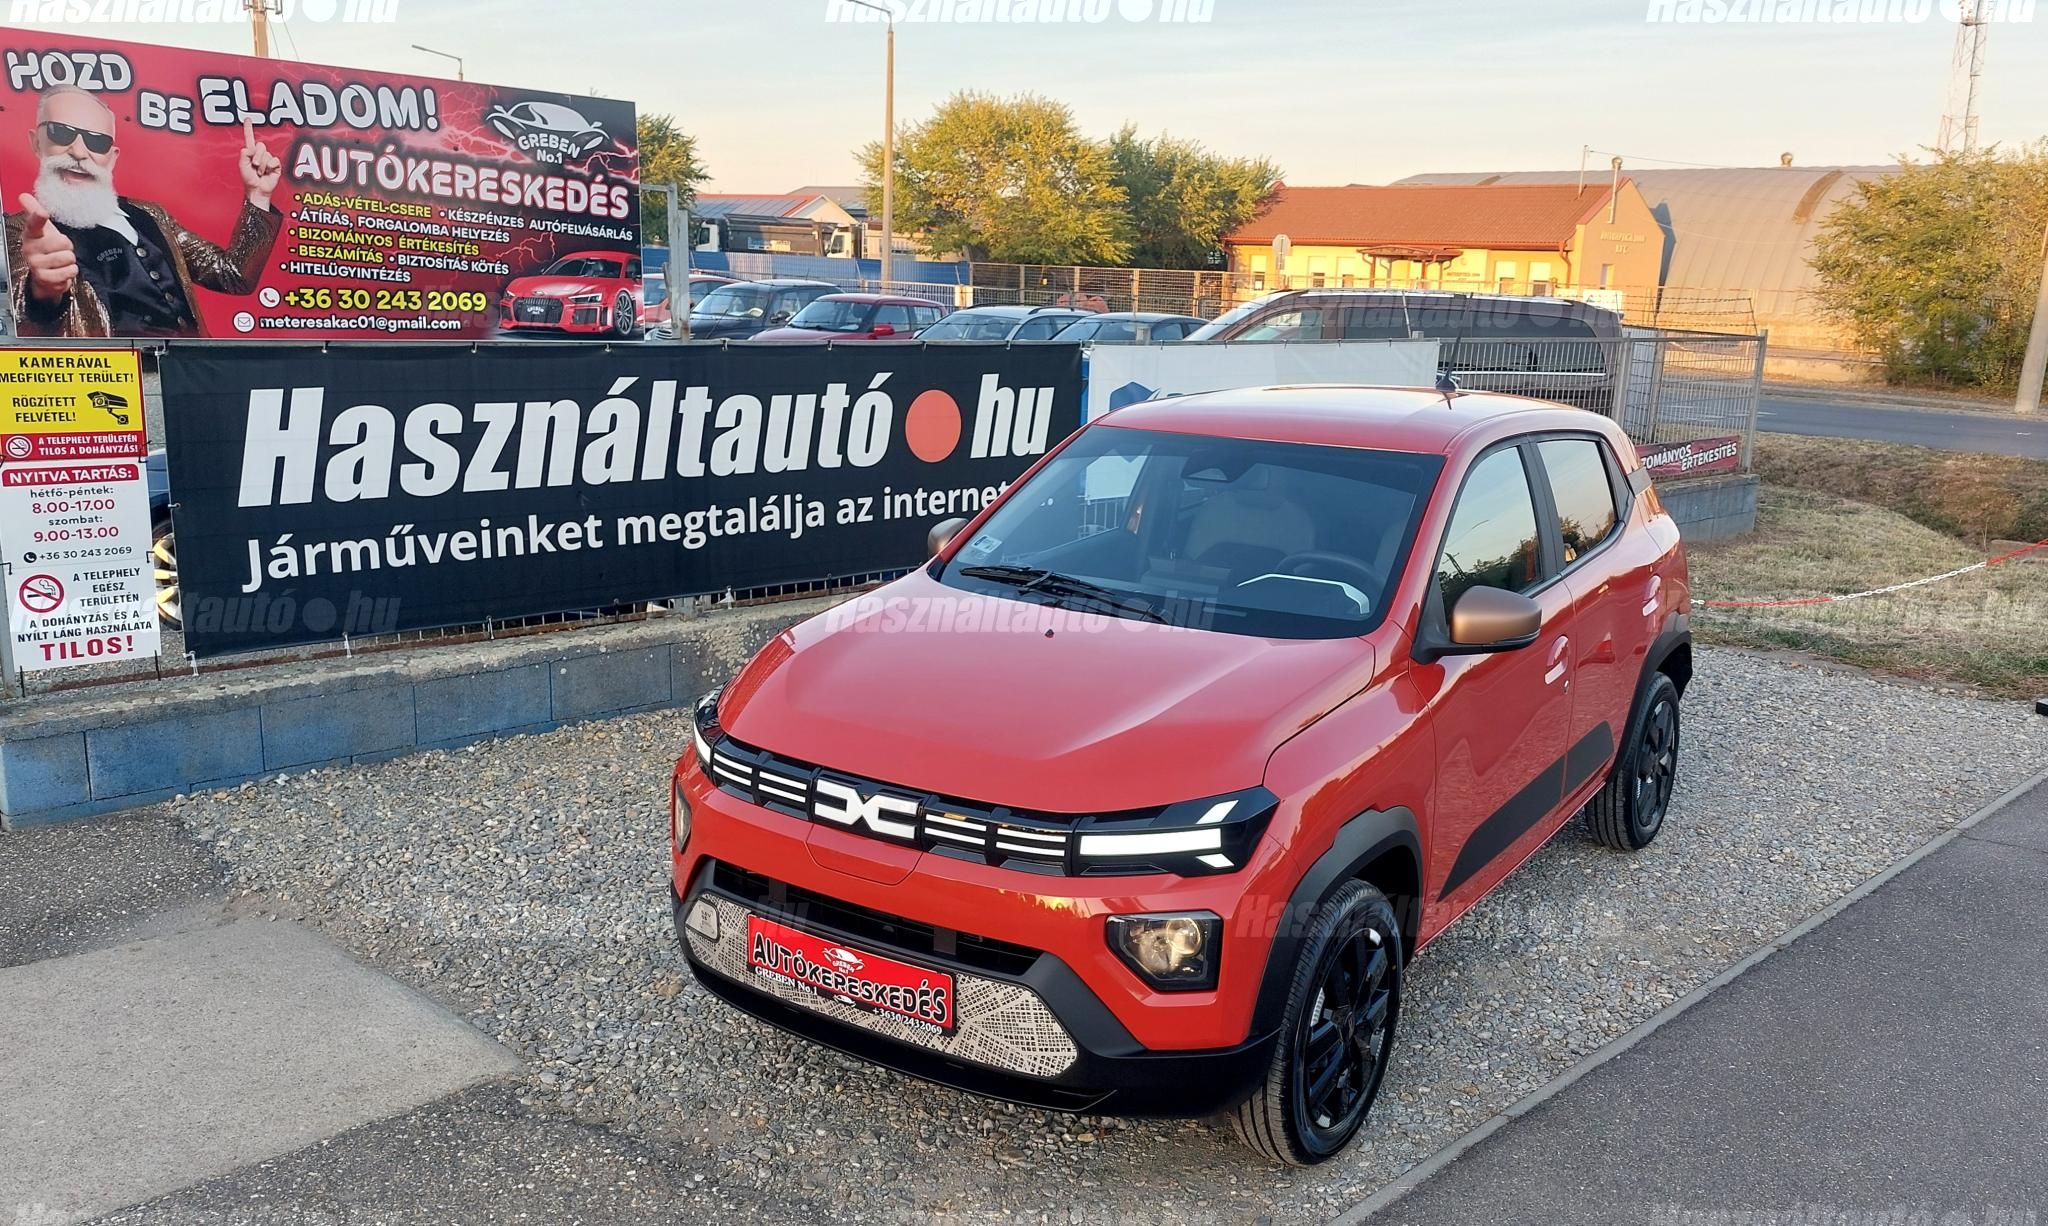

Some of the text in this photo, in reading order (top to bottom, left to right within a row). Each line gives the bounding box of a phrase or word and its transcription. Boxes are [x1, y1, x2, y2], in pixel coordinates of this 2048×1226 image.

[6, 50, 438, 133] HOZD BE ELADOM!
[518, 133, 580, 158] GREBEN
[537, 149, 563, 164] No.1
[294, 143, 629, 219] AUTÓKERESKEDÉS
[300, 206, 510, 243] ÁTÍRÁS, FORGALOMBA HELYEZÉS
[303, 192, 633, 241] ADÁS-VÉTEL-CSERE KÉSZPÉNZES AUTÓFELVÁSÁRLÁS
[299, 227, 480, 256] BIZOMÁNYOS ÉRTÉKESÍTÉS
[299, 245, 510, 275] BESZÁMÍTÁS BIZTOSÍTÁS KÖTÉS
[290, 261, 411, 282] HITELÜGYINTÉZÉS
[284, 288, 332, 309] +36
[337, 289, 371, 310] 30
[376, 289, 422, 310] 243
[427, 291, 487, 311] 2069
[260, 314, 461, 332] meteresakac01@gmail.com
[19, 355, 112, 369] KAMERÁVAL
[0, 370, 134, 383] MEGFIGYELT TERÜLET!
[12, 394, 77, 408] RÖGZÍTETT
[15, 410, 76, 423] FELVÉTEL!
[38, 433, 138, 445] A TELEPHELY TERÜLETÉN
[237, 372, 1055, 508] Használtautó hu
[39, 444, 139, 456] TILOS A DOHÁNYZÁS!
[1640, 444, 1691, 470] ZOMÁNYOS
[1681, 441, 1737, 471] ÉRTÉKESÍTÉS
[9, 465, 132, 484] NYITVA TARTÁS:
[32, 499, 115, 514] 8.00-17.00
[49, 515, 103, 526] szombat:
[33, 526, 119, 543] 9.00-13.00
[242, 513, 603, 593] Járműveinket
[617, 494, 825, 550] megtalálja
[836, 495, 874, 526] az
[39, 546, 132, 560] +36 30 243 2069
[73, 567, 141, 582] A TELEPHELY
[92, 582, 125, 593] EGÉSZ
[80, 594, 139, 607] TERÜLETÉN
[30, 609, 140, 629] A DOHÁNYZÁS ÉS A
[18, 620, 152, 643] NYÍLT LÁNG HASZNÁLATA
[40, 635, 134, 661] TILOS!
[753, 931, 947, 1023] AUTÓKERESKEDÉS
[755, 966, 943, 1035] GREBEN No.1 +3630/2432069
